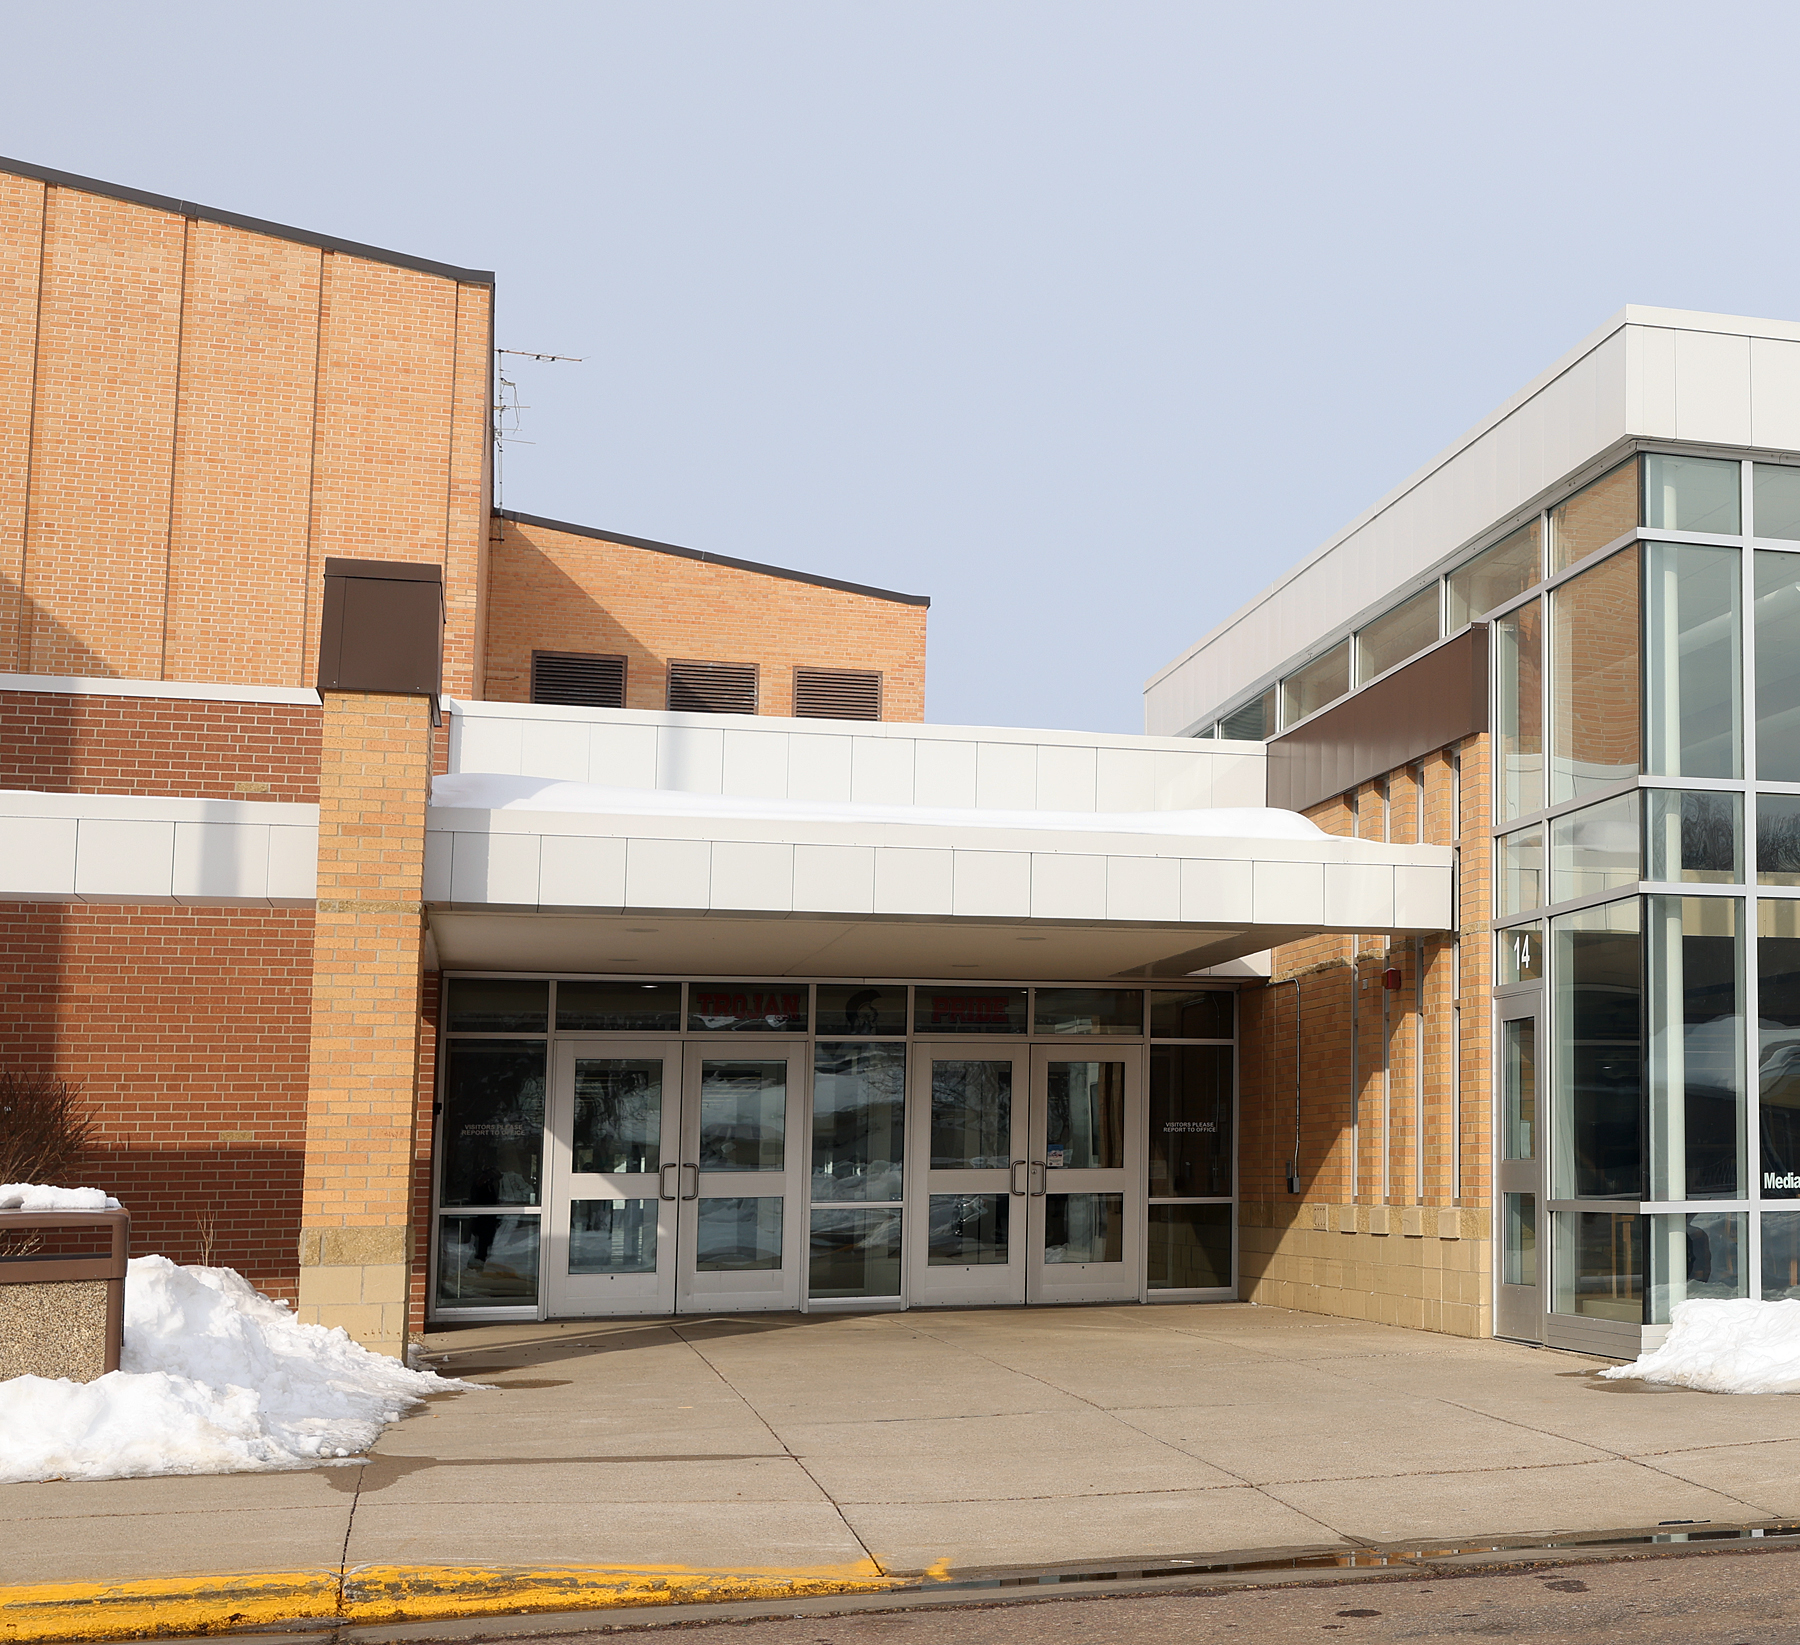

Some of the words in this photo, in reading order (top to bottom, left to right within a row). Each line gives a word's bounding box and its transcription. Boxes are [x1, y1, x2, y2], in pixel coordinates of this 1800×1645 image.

[1513, 934, 1531, 971] 14
[696, 992, 801, 1021] TROJAN
[931, 995, 1010, 1024] PRIDE
